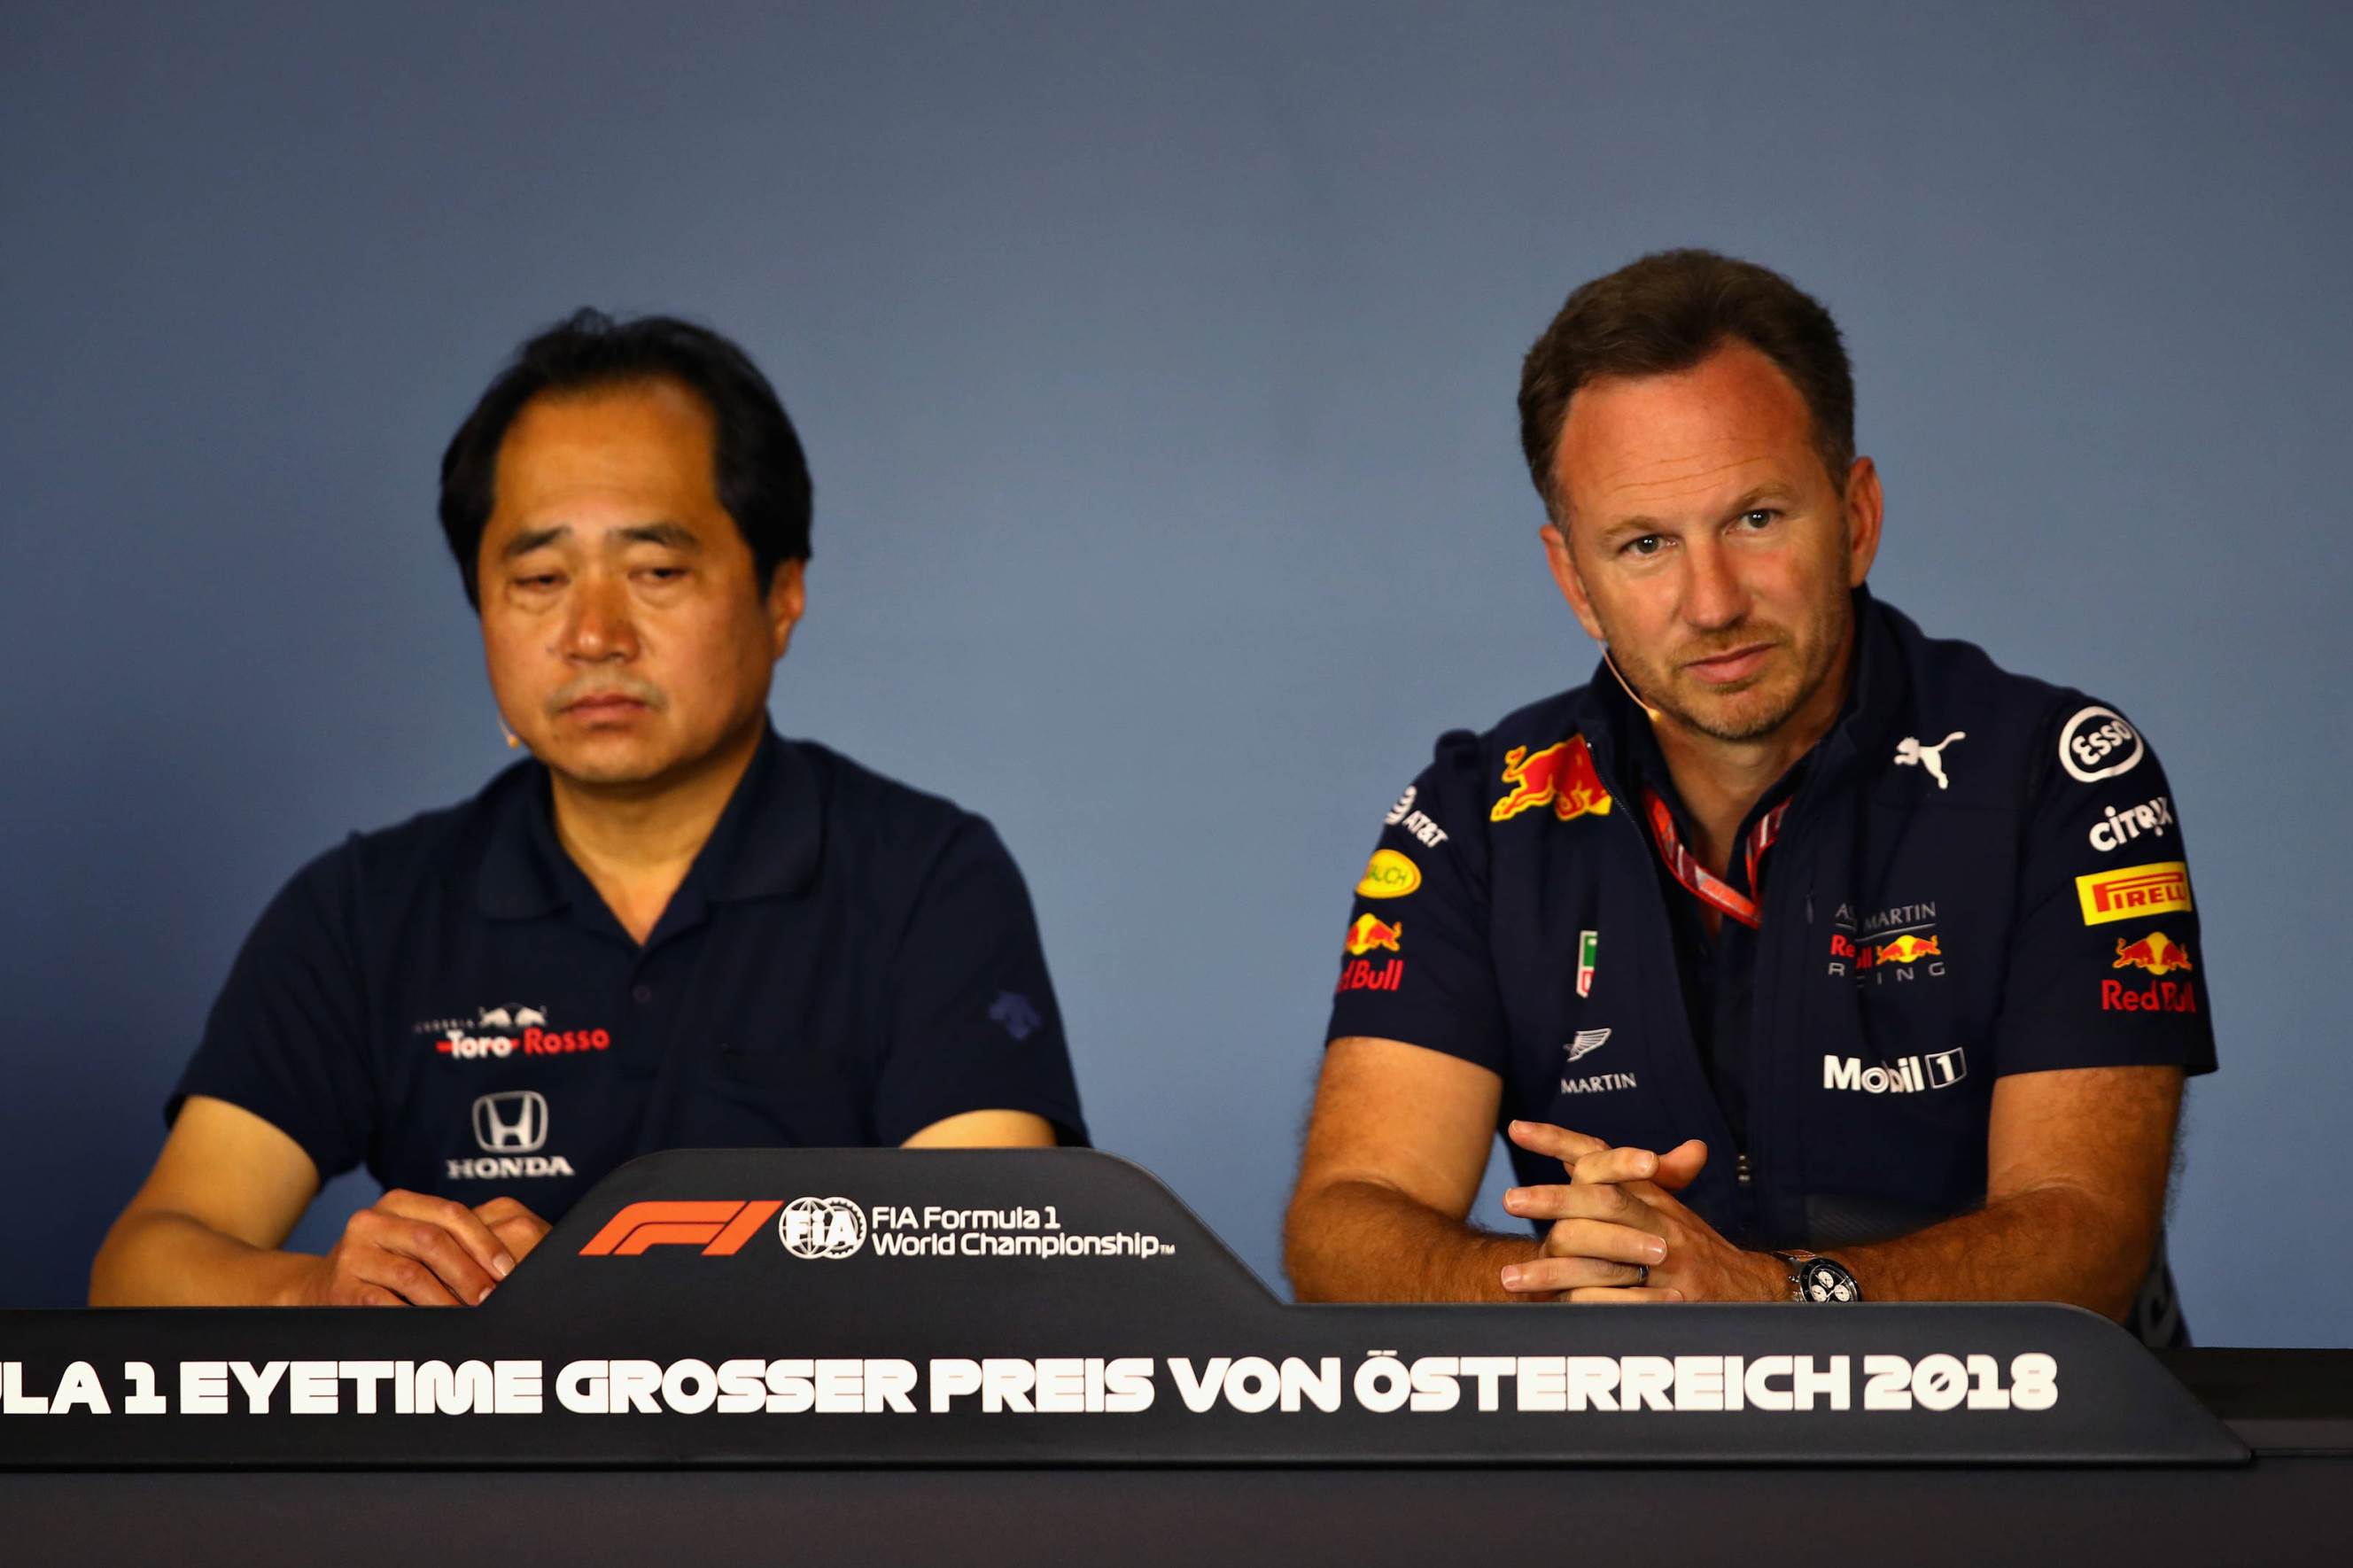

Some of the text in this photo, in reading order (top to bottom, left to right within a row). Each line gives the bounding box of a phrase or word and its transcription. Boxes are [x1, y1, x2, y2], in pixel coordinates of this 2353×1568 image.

[1402, 810, 1448, 848] AT&T
[2101, 979, 2160, 1012] Red
[446, 1027, 610, 1058] Toro Rosso
[1560, 1073, 1637, 1094] MARTIN
[1823, 1054, 1956, 1093] Mobil 1
[447, 1156, 574, 1179] HONDA
[872, 1206, 1061, 1230] FIA Formula 1
[871, 1232, 956, 1256] World
[0, 1349, 2059, 1415] LA 1 EYETIME GROSSER PREIS VON ÖSTERREICH 2018
